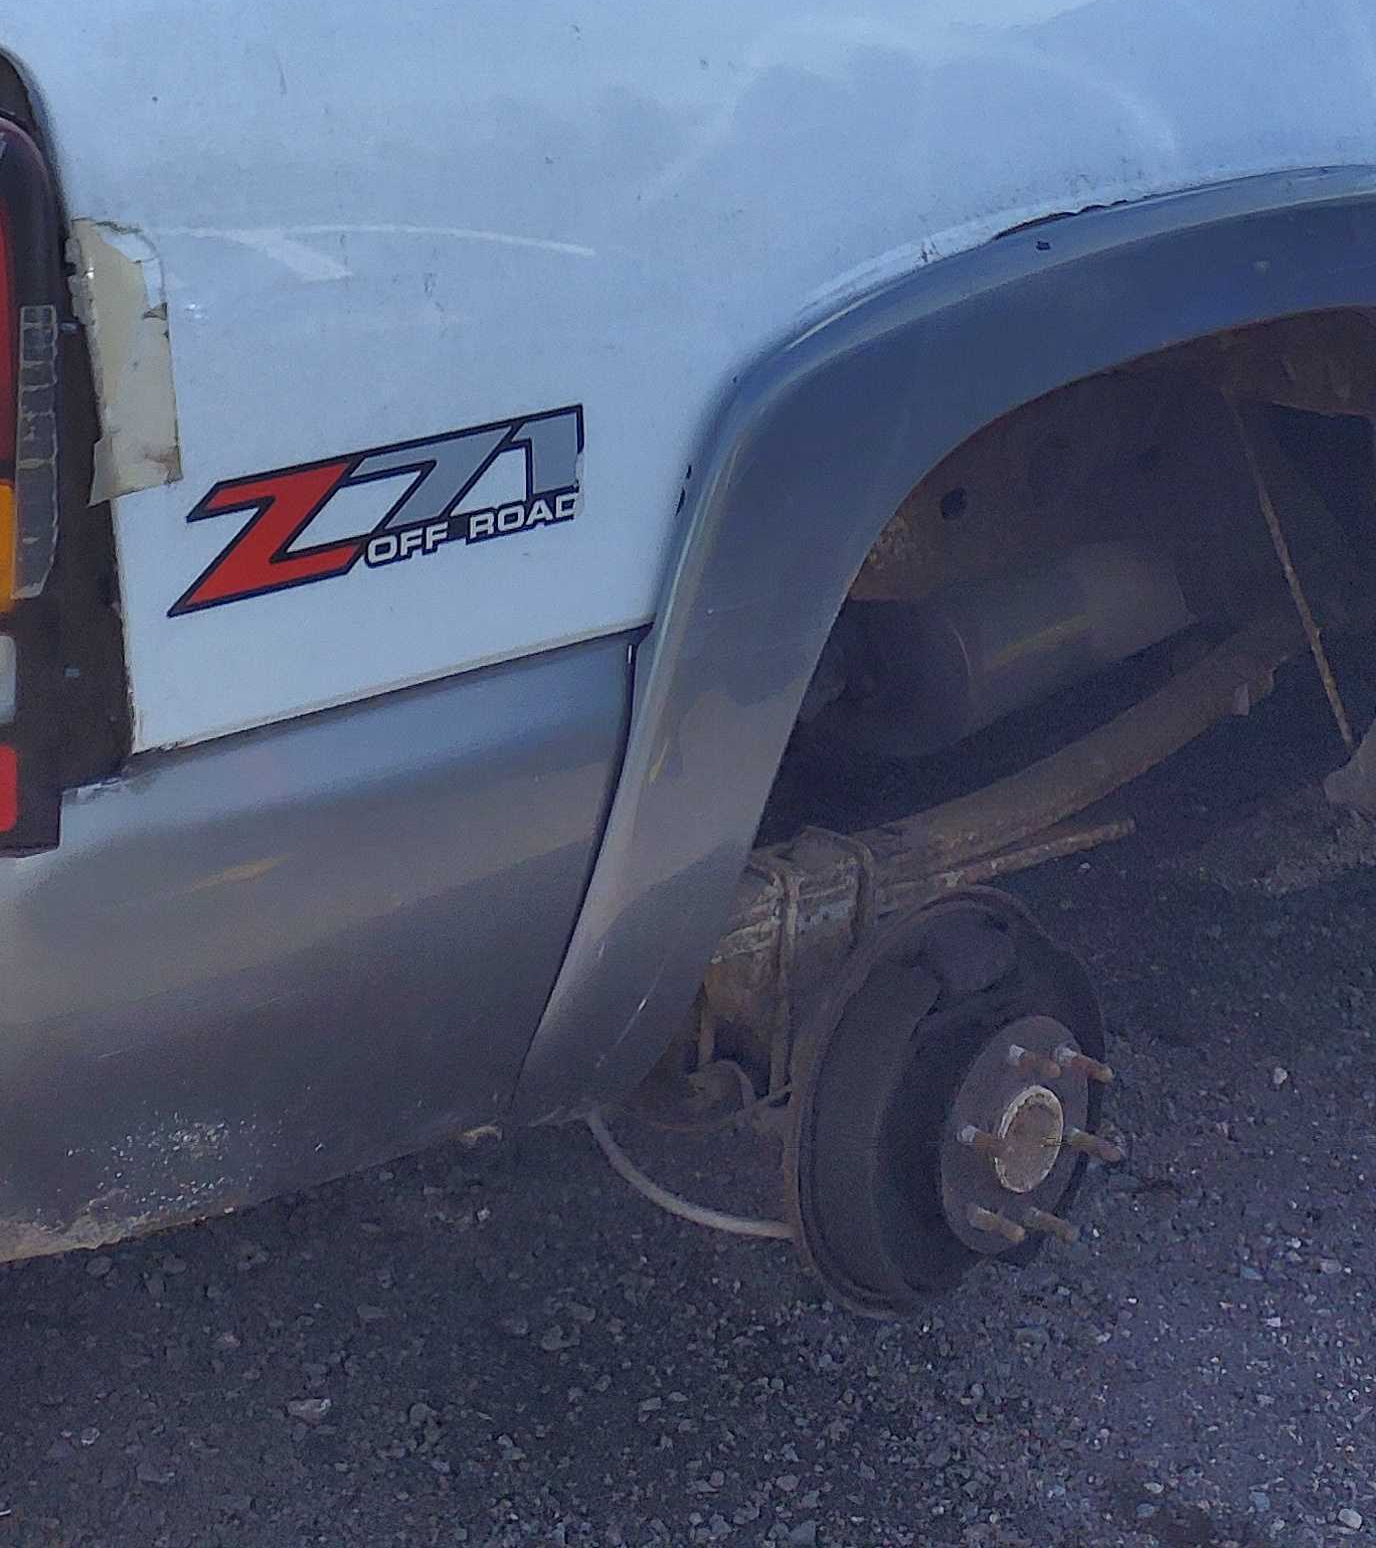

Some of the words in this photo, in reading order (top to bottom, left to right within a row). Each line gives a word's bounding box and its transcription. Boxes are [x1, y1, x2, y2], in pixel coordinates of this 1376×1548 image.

[166, 404, 584, 618] Z71
[366, 521, 449, 566] OFF
[468, 491, 580, 541] ROAD
